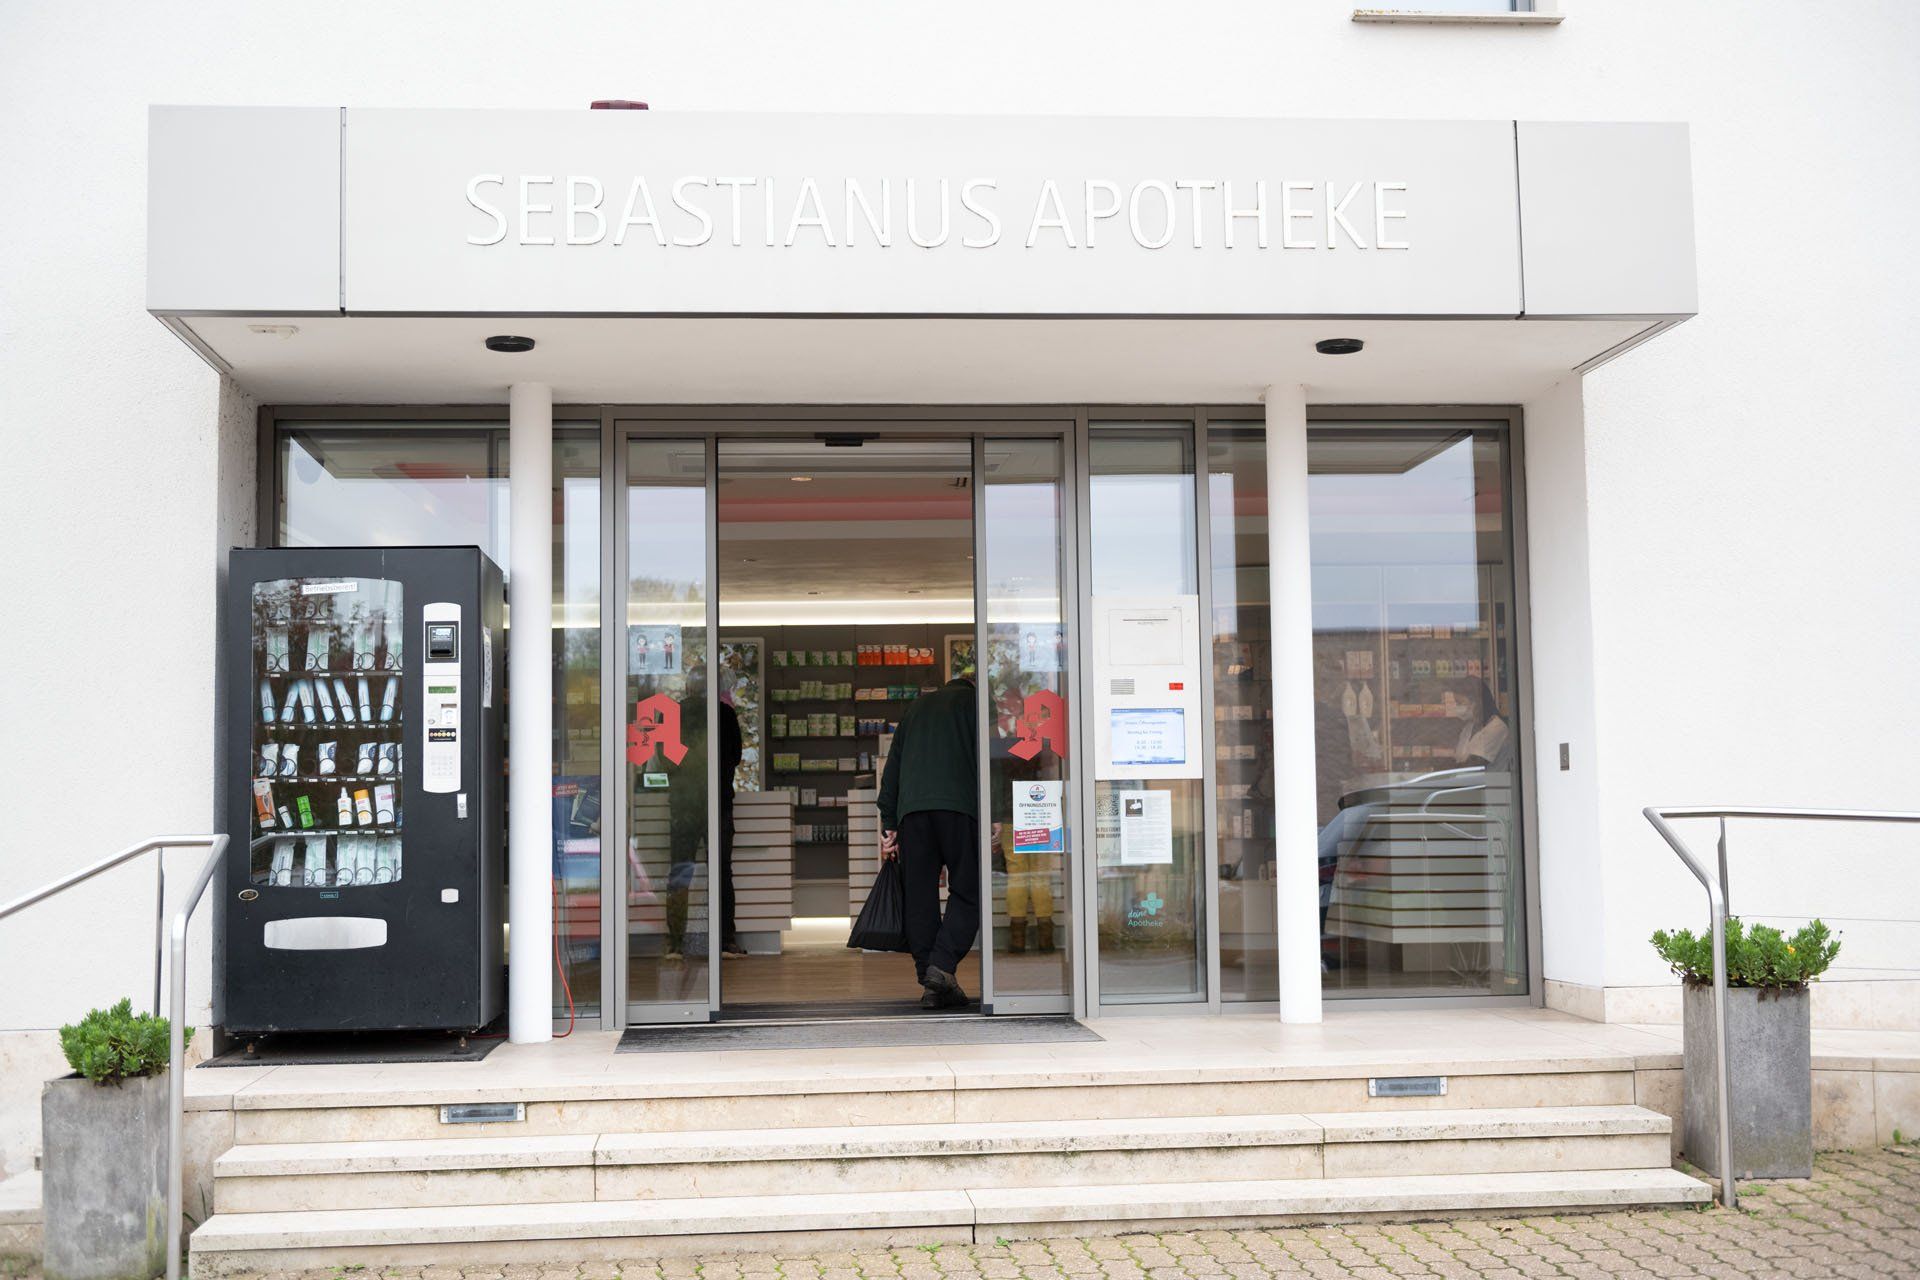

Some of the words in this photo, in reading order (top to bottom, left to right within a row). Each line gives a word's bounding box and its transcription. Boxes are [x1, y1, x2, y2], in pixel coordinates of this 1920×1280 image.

[465, 174, 1001, 248] SEBASTIANUS
[1025, 178, 1411, 250] APOTHEKE
[1127, 919, 1164, 928] Apotheke
